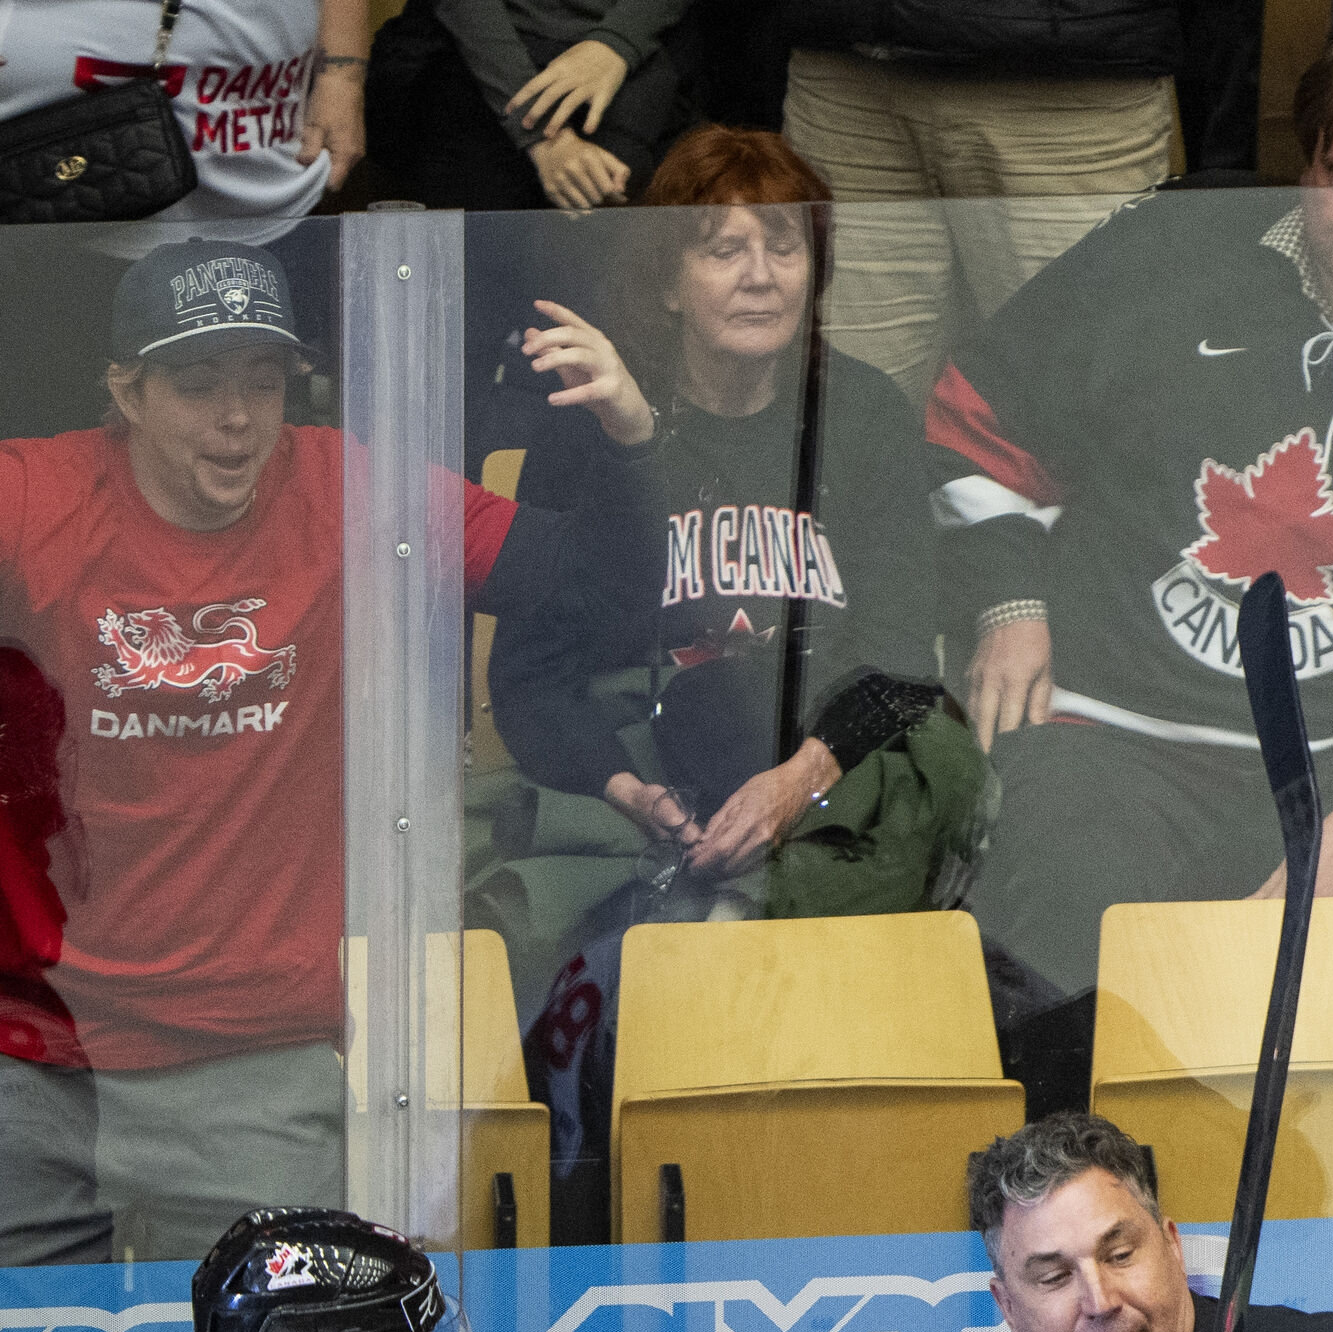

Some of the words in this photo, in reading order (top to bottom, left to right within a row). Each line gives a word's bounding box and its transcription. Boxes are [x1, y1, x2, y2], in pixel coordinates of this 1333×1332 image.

[192, 102, 299, 153] METAL
[170, 257, 280, 310] PANTHERS
[91, 700, 290, 740] DANMARK
